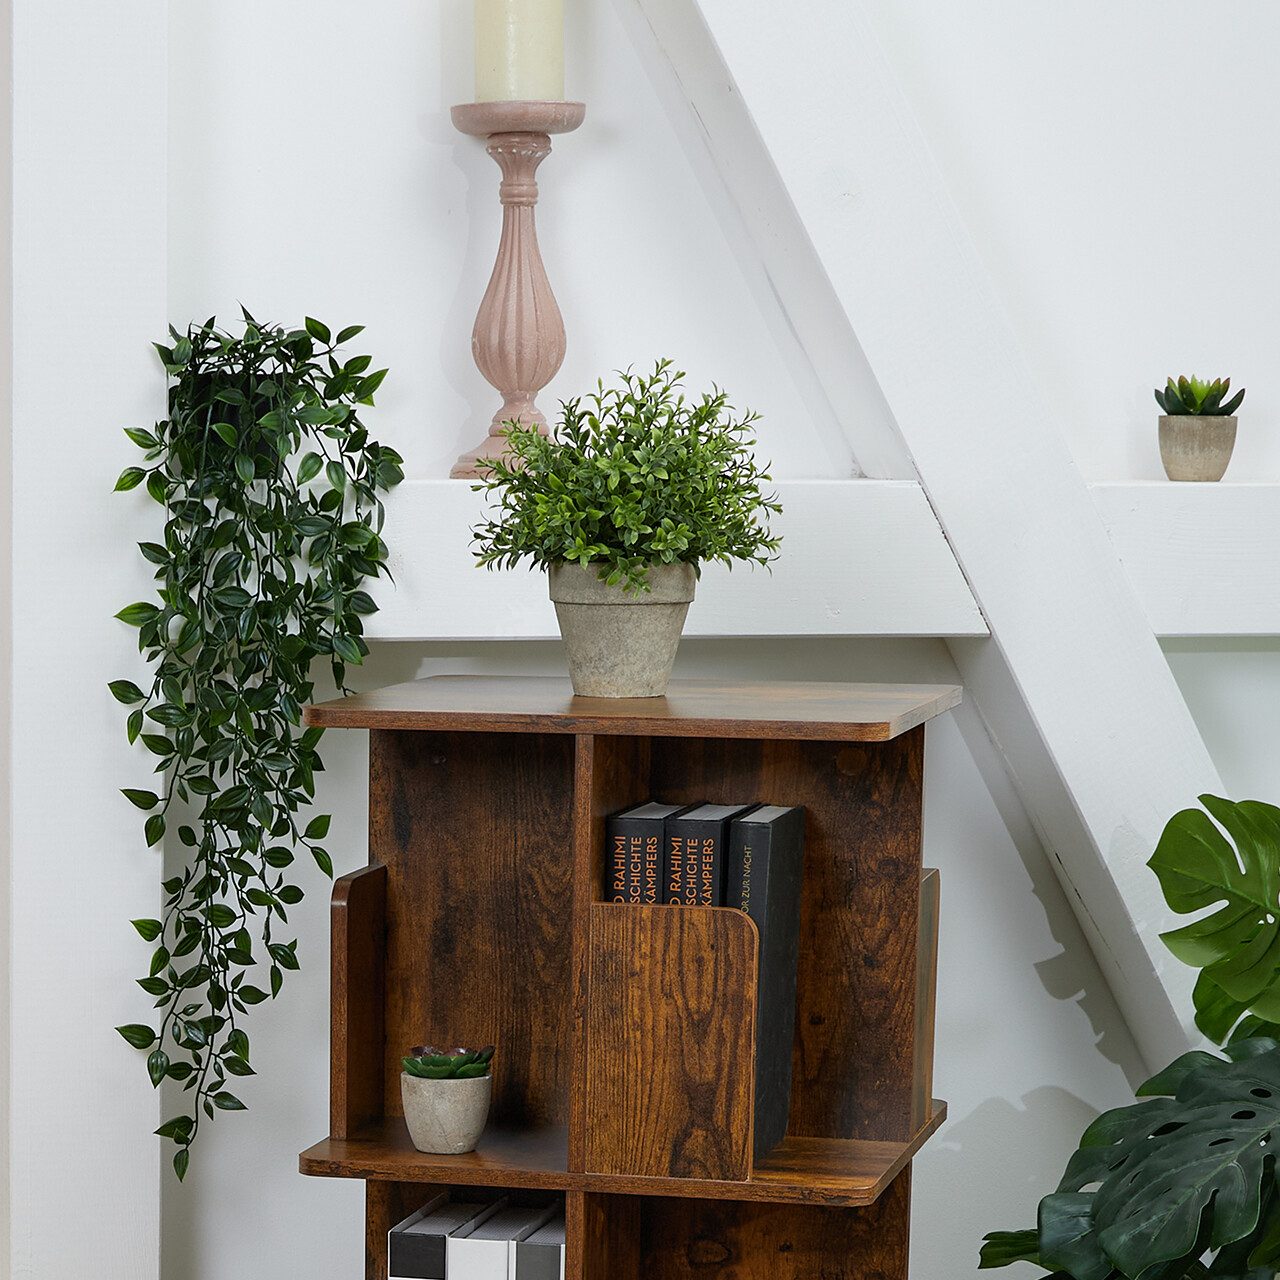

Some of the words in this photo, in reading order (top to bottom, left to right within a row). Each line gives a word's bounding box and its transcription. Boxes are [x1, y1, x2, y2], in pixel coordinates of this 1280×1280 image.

[614, 836, 626, 890] RAHIMI
[630, 837, 642, 904] SCHICHTE
[670, 837, 682, 892] RAHIMI
[685, 838, 698, 906] SCHICHTE
[700, 838, 714, 907] KÄMPFERS
[742, 845, 752, 877] NACHT
[740, 900, 749, 914] OR
[741, 879, 751, 898] ZUR
